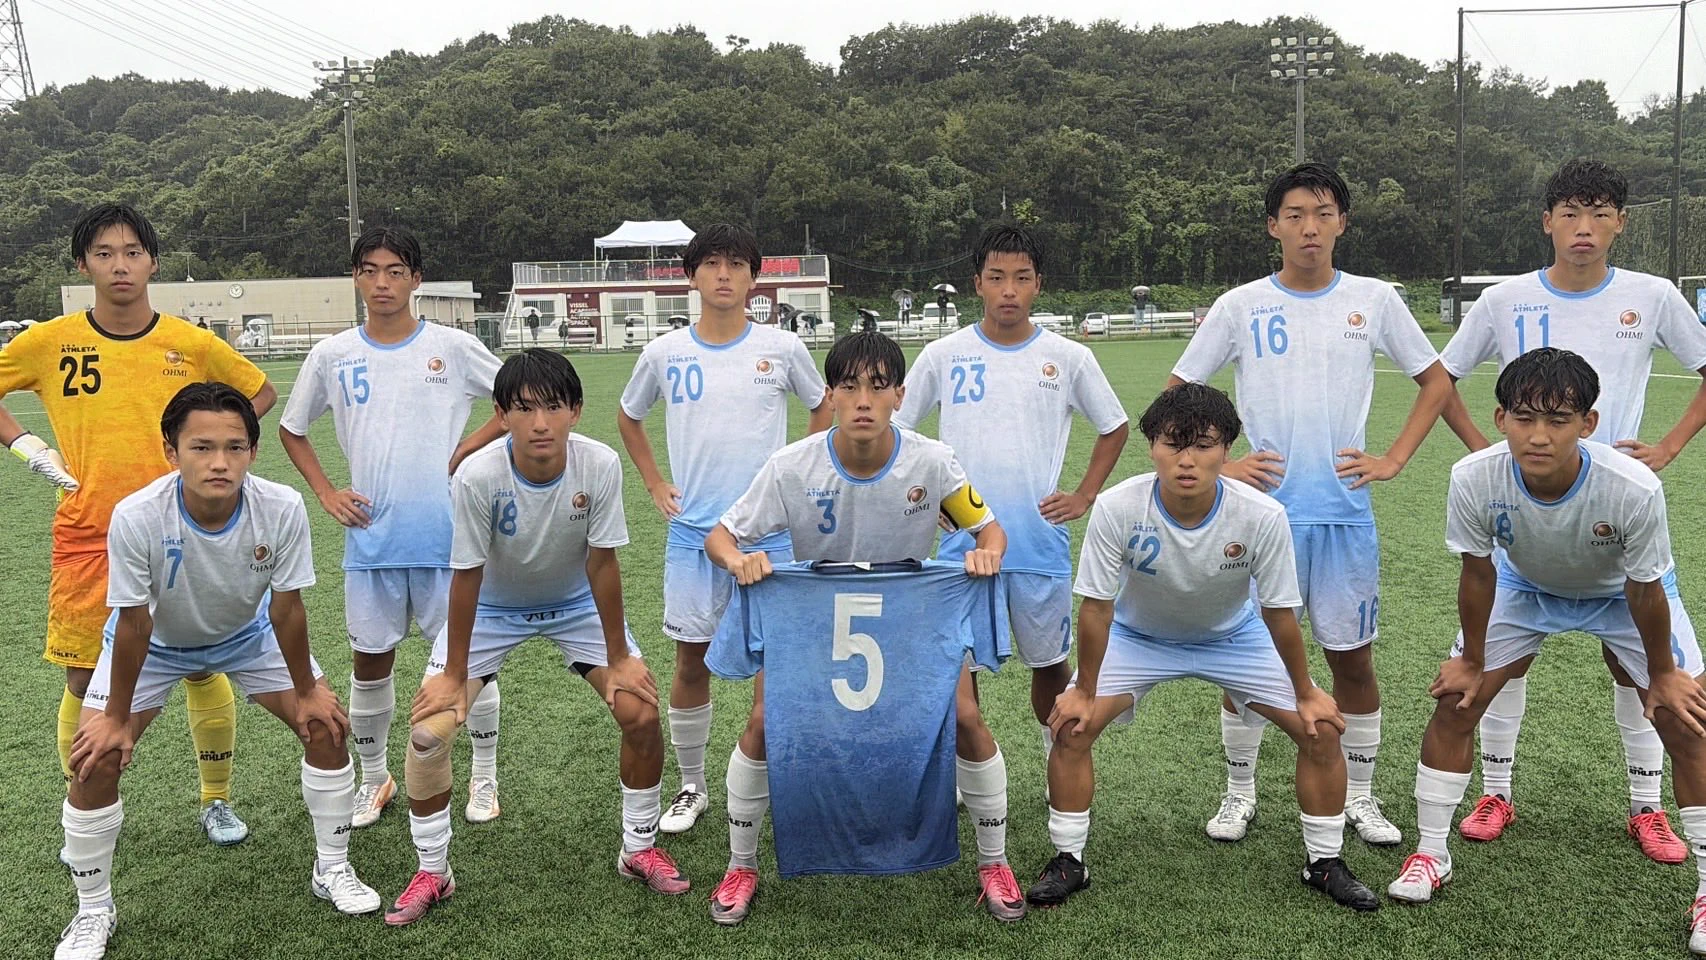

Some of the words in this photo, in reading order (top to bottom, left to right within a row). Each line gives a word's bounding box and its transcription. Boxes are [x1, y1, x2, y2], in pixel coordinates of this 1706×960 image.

[1251, 305, 1284, 316] ATHLETA
[1513, 305, 1548, 313] ATHLETA
[1250, 314, 1288, 358] 16
[1343, 331, 1369, 341] OHMI
[1515, 313, 1549, 356] 11
[1616, 331, 1643, 340] OHMI
[952, 355, 982, 363] ATHLETA
[59, 354, 101, 397] 25
[162, 368, 187, 377] OHMI
[425, 376, 448, 385] OHMI
[667, 363, 704, 404] 20
[754, 377, 777, 385] OHMI
[950, 364, 986, 404] 23
[1039, 380, 1061, 391] OHMI
[338, 366, 370, 407] 15
[806, 489, 841, 498] ATHLETA
[904, 503, 930, 516] OHMI
[491, 499, 518, 536] 18
[816, 498, 837, 535] 3
[166, 548, 183, 590] 7
[1219, 561, 1249, 571] OHMI
[831, 592, 885, 712] 5
[354, 736, 375, 745] LETA
[200, 750, 233, 761] ATHLETA
[72, 867, 102, 878] LETA
